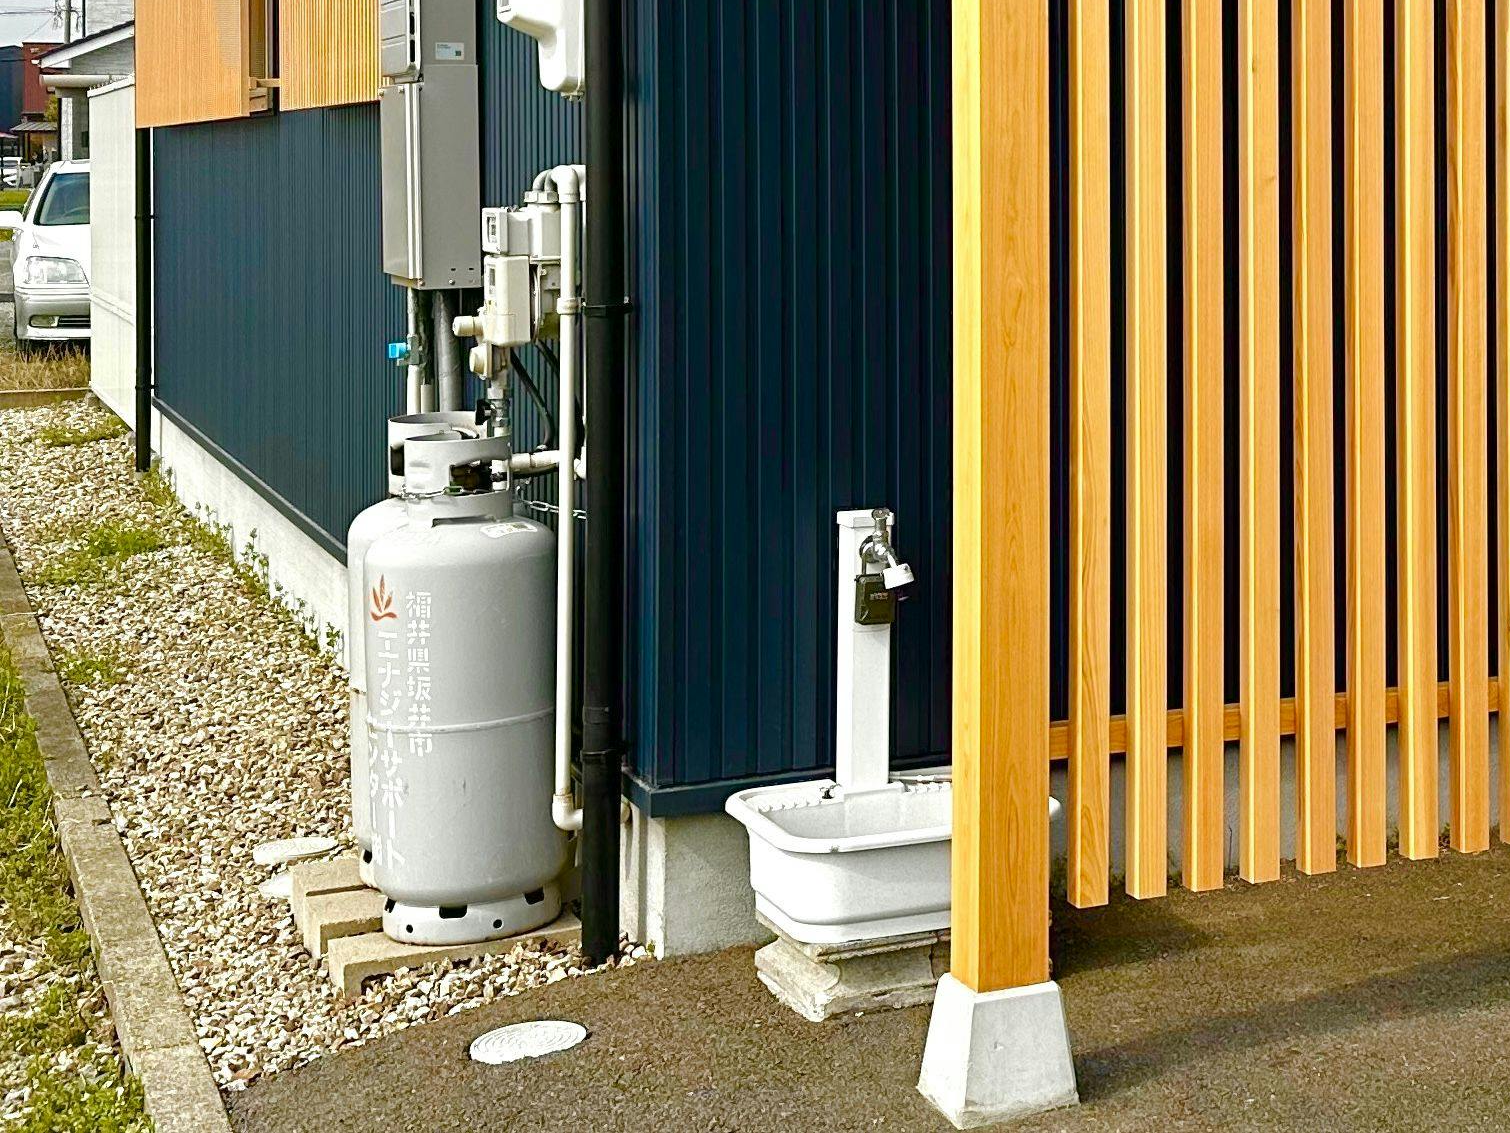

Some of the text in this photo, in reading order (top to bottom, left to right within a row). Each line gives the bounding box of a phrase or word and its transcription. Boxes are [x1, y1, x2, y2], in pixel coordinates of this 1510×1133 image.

[377, 631, 406, 869] エナジーサポート
[405, 590, 432, 757] 福井県坂井市
